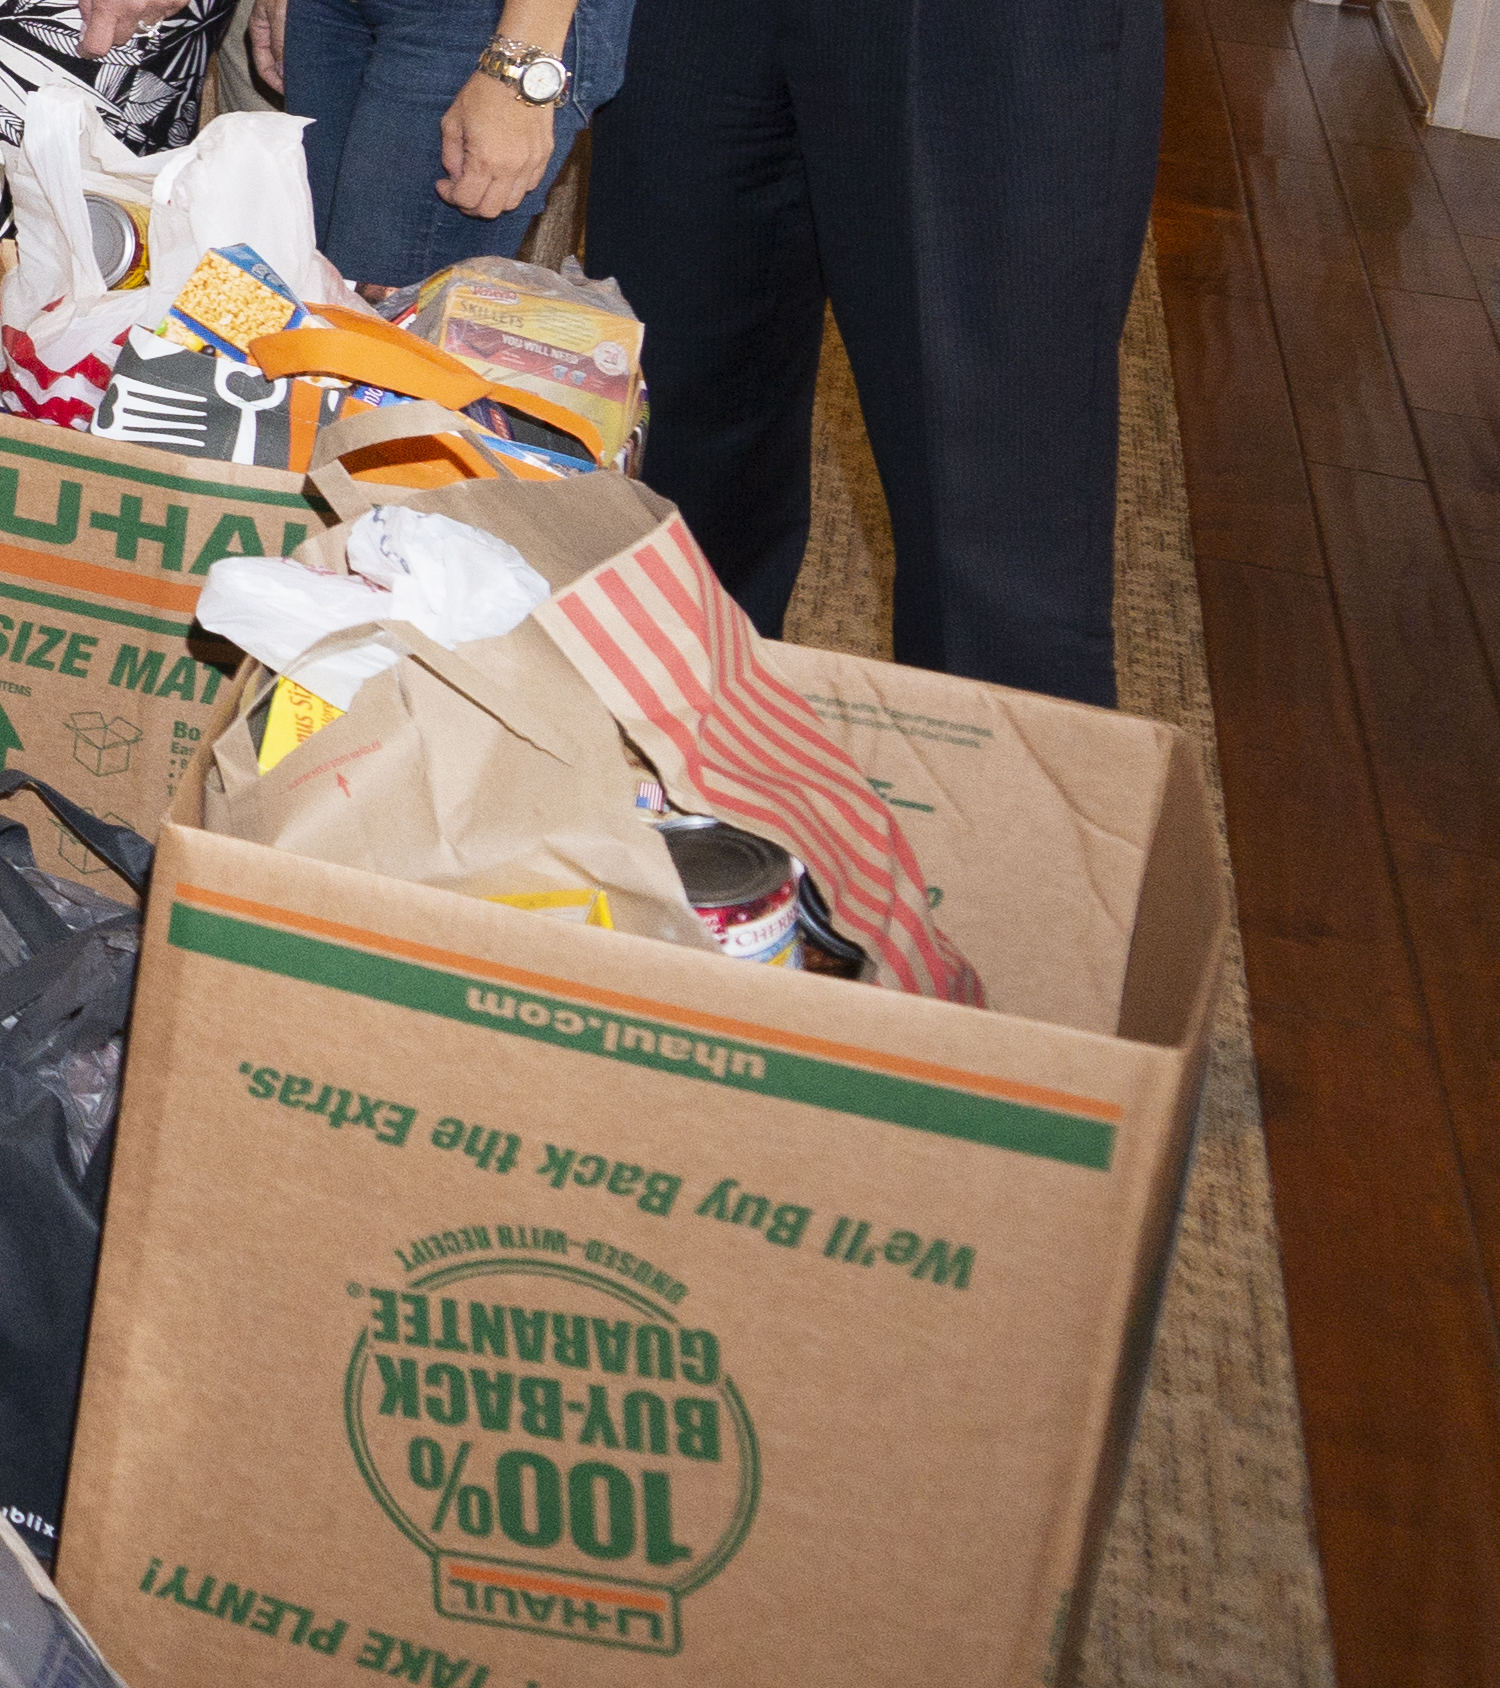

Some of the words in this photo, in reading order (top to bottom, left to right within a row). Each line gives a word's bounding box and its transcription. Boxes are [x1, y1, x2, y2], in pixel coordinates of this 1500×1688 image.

[459, 300, 524, 329] SKILLETS
[501, 333, 523, 350] YOU
[523, 339, 549, 357] WILL
[466, 987, 766, 1080] uhaul.com
[237, 1061, 417, 1147] Extras.
[431, 1115, 522, 1172] the
[544, 1143, 683, 1216] Back
[394, 1226, 491, 1272] RECEIPT
[697, 1178, 811, 1248] Buy
[825, 1209, 977, 1291] We'll
[377, 1354, 723, 1462] BUY-BACK
[408, 1437, 691, 1565] 100%
[140, 1558, 347, 1657] PLENTY!
[449, 1578, 665, 1643] U-HAUL
